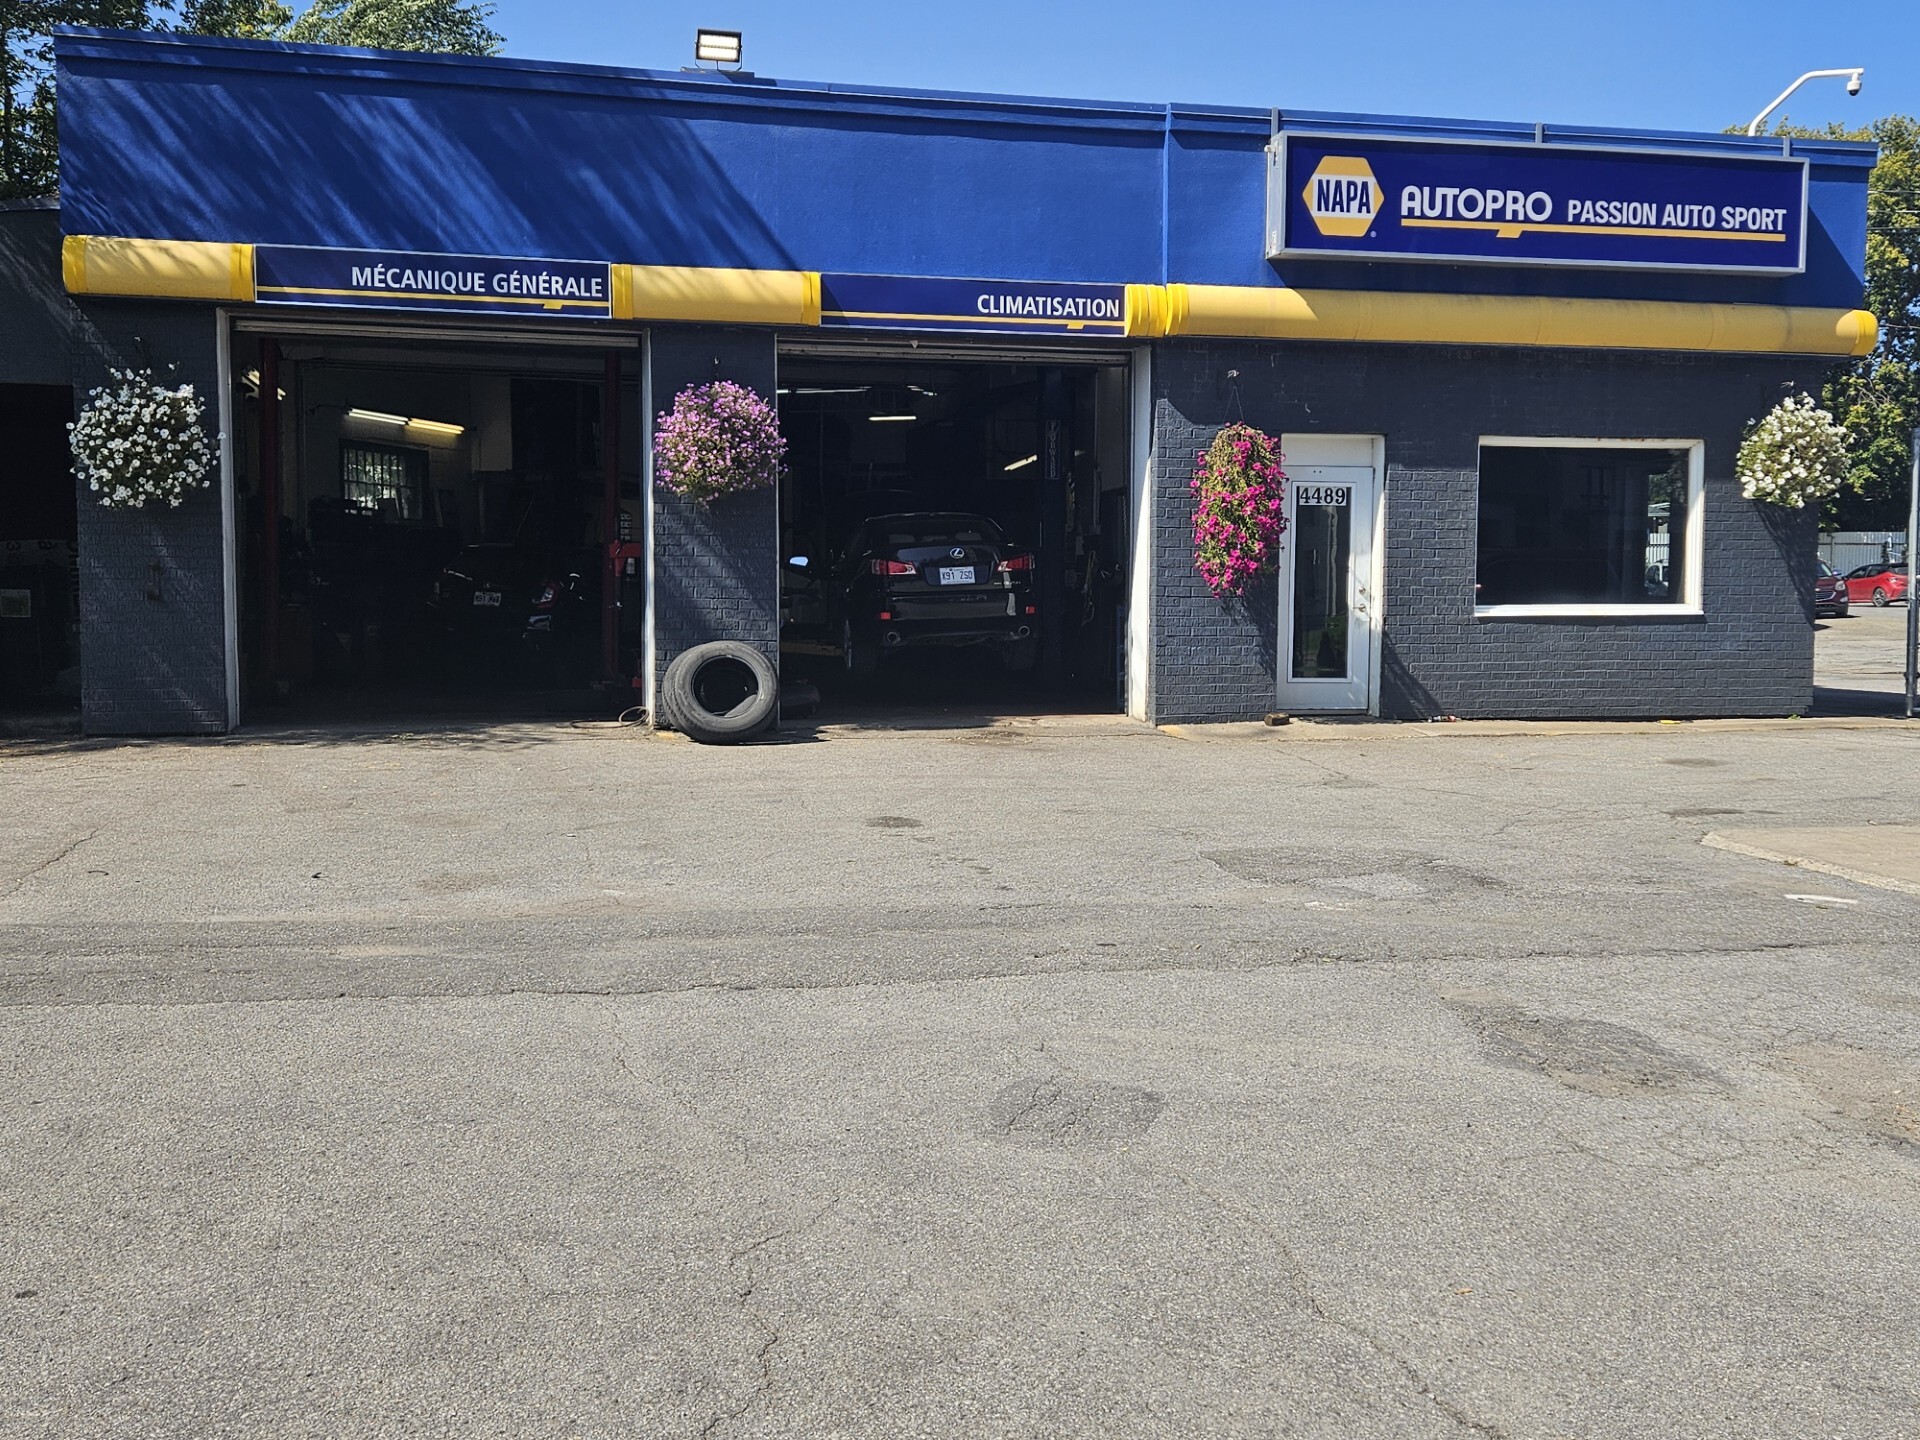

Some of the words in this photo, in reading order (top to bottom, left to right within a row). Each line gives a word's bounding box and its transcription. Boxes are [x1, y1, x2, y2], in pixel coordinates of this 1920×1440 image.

[1317, 179, 1371, 214] NAPA
[1401, 185, 1553, 222] AUTOPRO
[1567, 199, 1657, 226] PASSION
[1661, 204, 1716, 228] AUTO
[1721, 206, 1787, 231] SPORT
[351, 264, 485, 294] MÉCANIQUE
[493, 269, 602, 298] GÉNÉRALE
[977, 294, 1120, 318] CLIMATISATION
[1300, 487, 1346, 504] 4489
